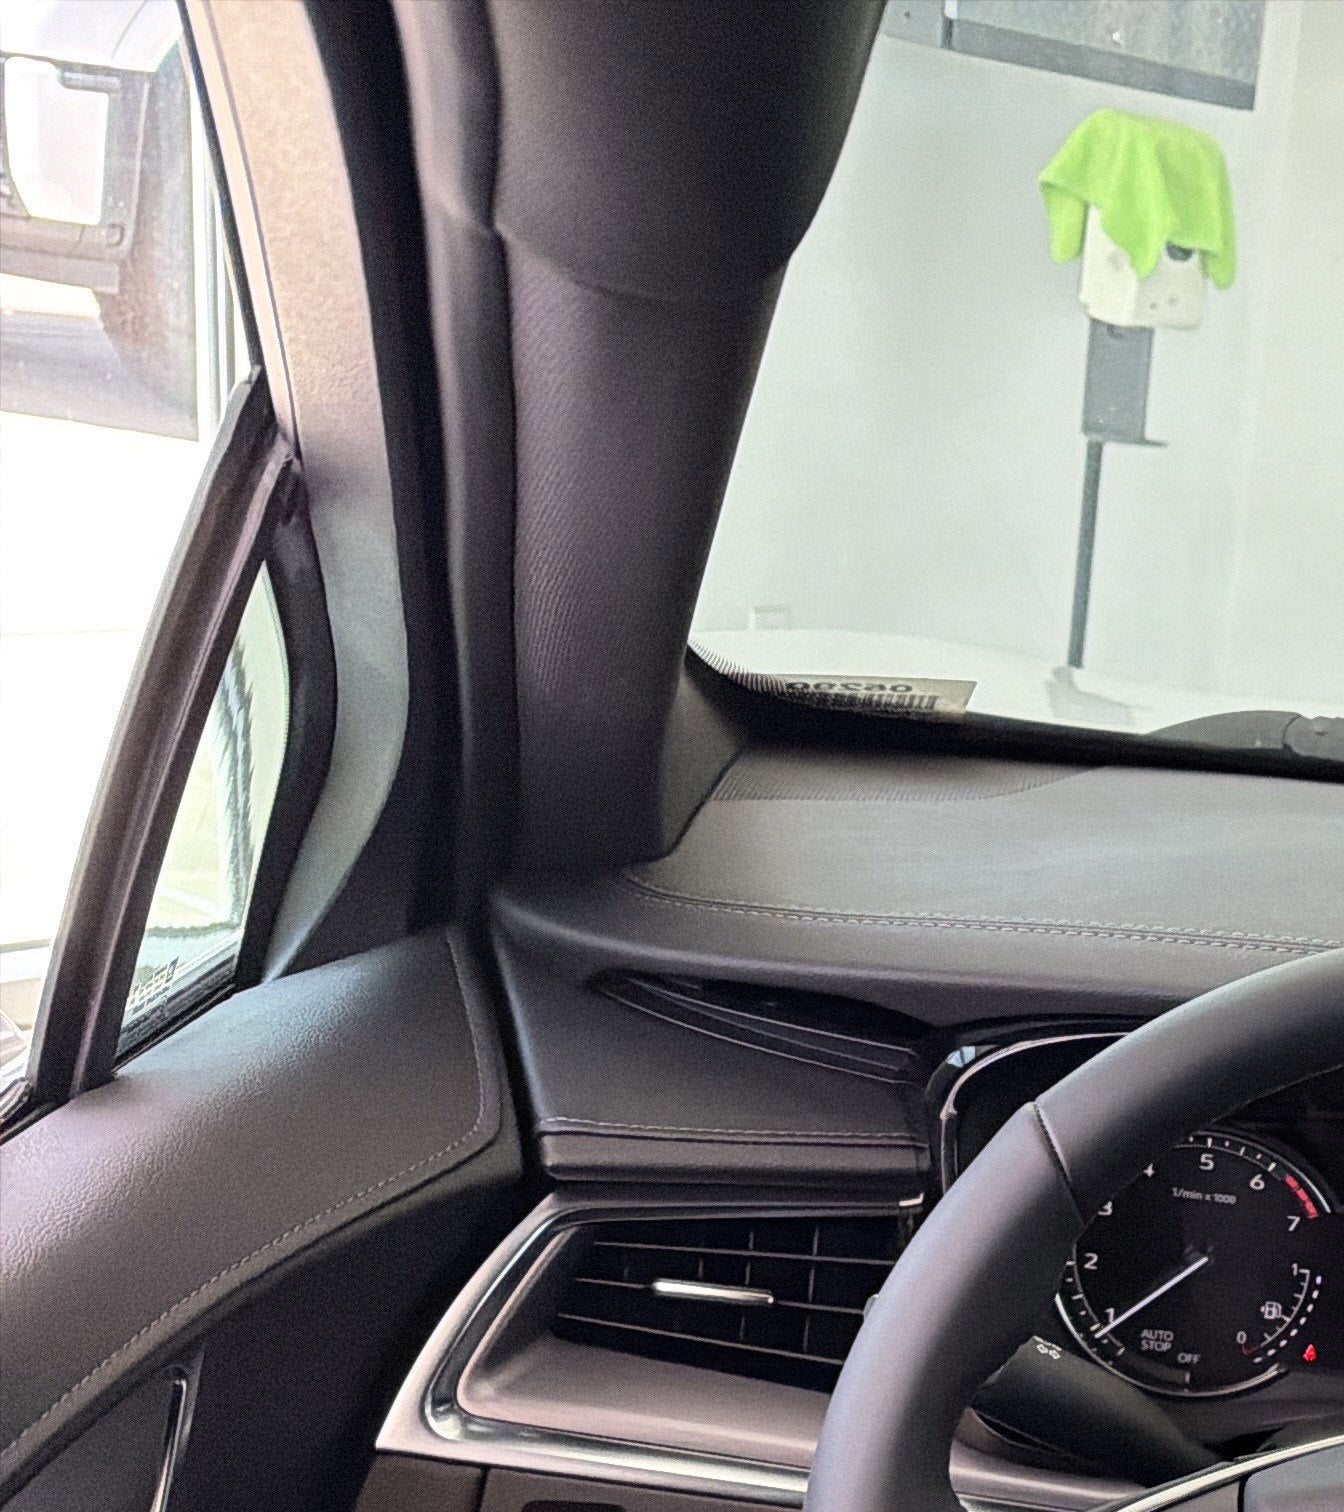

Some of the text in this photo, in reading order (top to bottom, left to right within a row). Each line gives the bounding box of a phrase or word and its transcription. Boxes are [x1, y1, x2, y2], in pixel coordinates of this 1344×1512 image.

[1199, 1153, 1214, 1171] 5
[1249, 1174, 1265, 1191] 6
[1286, 1215, 1302, 1232] 7
[1083, 1252, 1099, 1270] 2
[1104, 1307, 1115, 1323] 1
[1141, 1329, 1174, 1343] AUTO
[1236, 1331, 1247, 1344] 0
[1141, 1340, 1172, 1353] STOP
[1177, 1352, 1200, 1364] OFF
